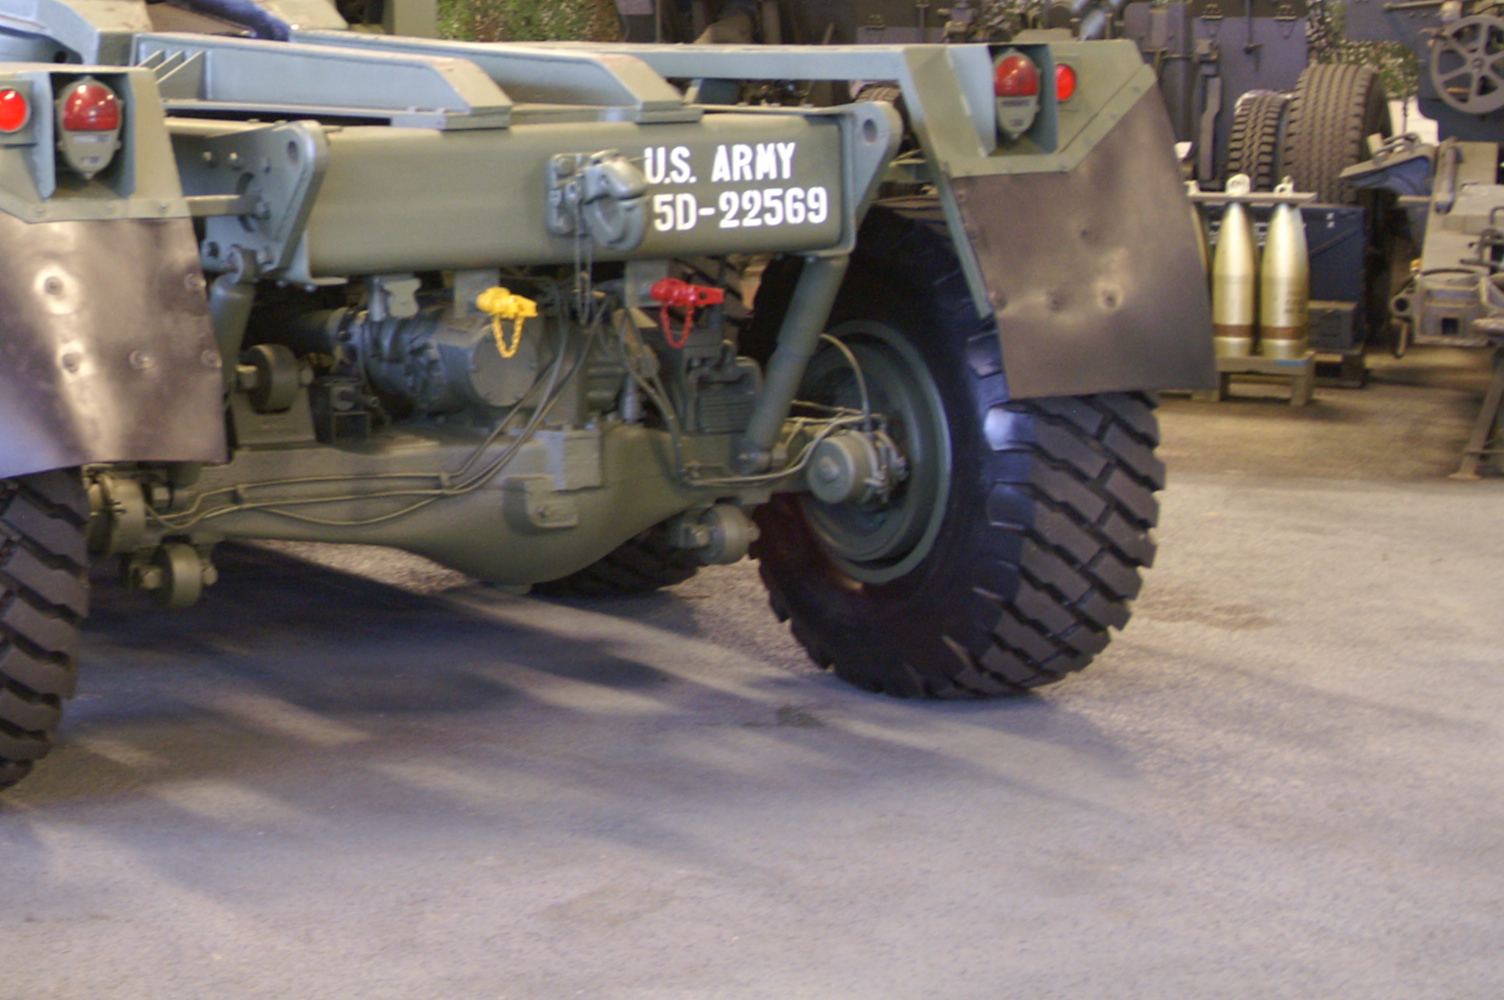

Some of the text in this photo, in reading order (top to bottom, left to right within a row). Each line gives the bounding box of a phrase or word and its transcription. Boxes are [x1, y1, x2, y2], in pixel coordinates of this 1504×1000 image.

[644, 142, 796, 184] U.S. ARMY
[653, 186, 828, 231] 5D-22569
